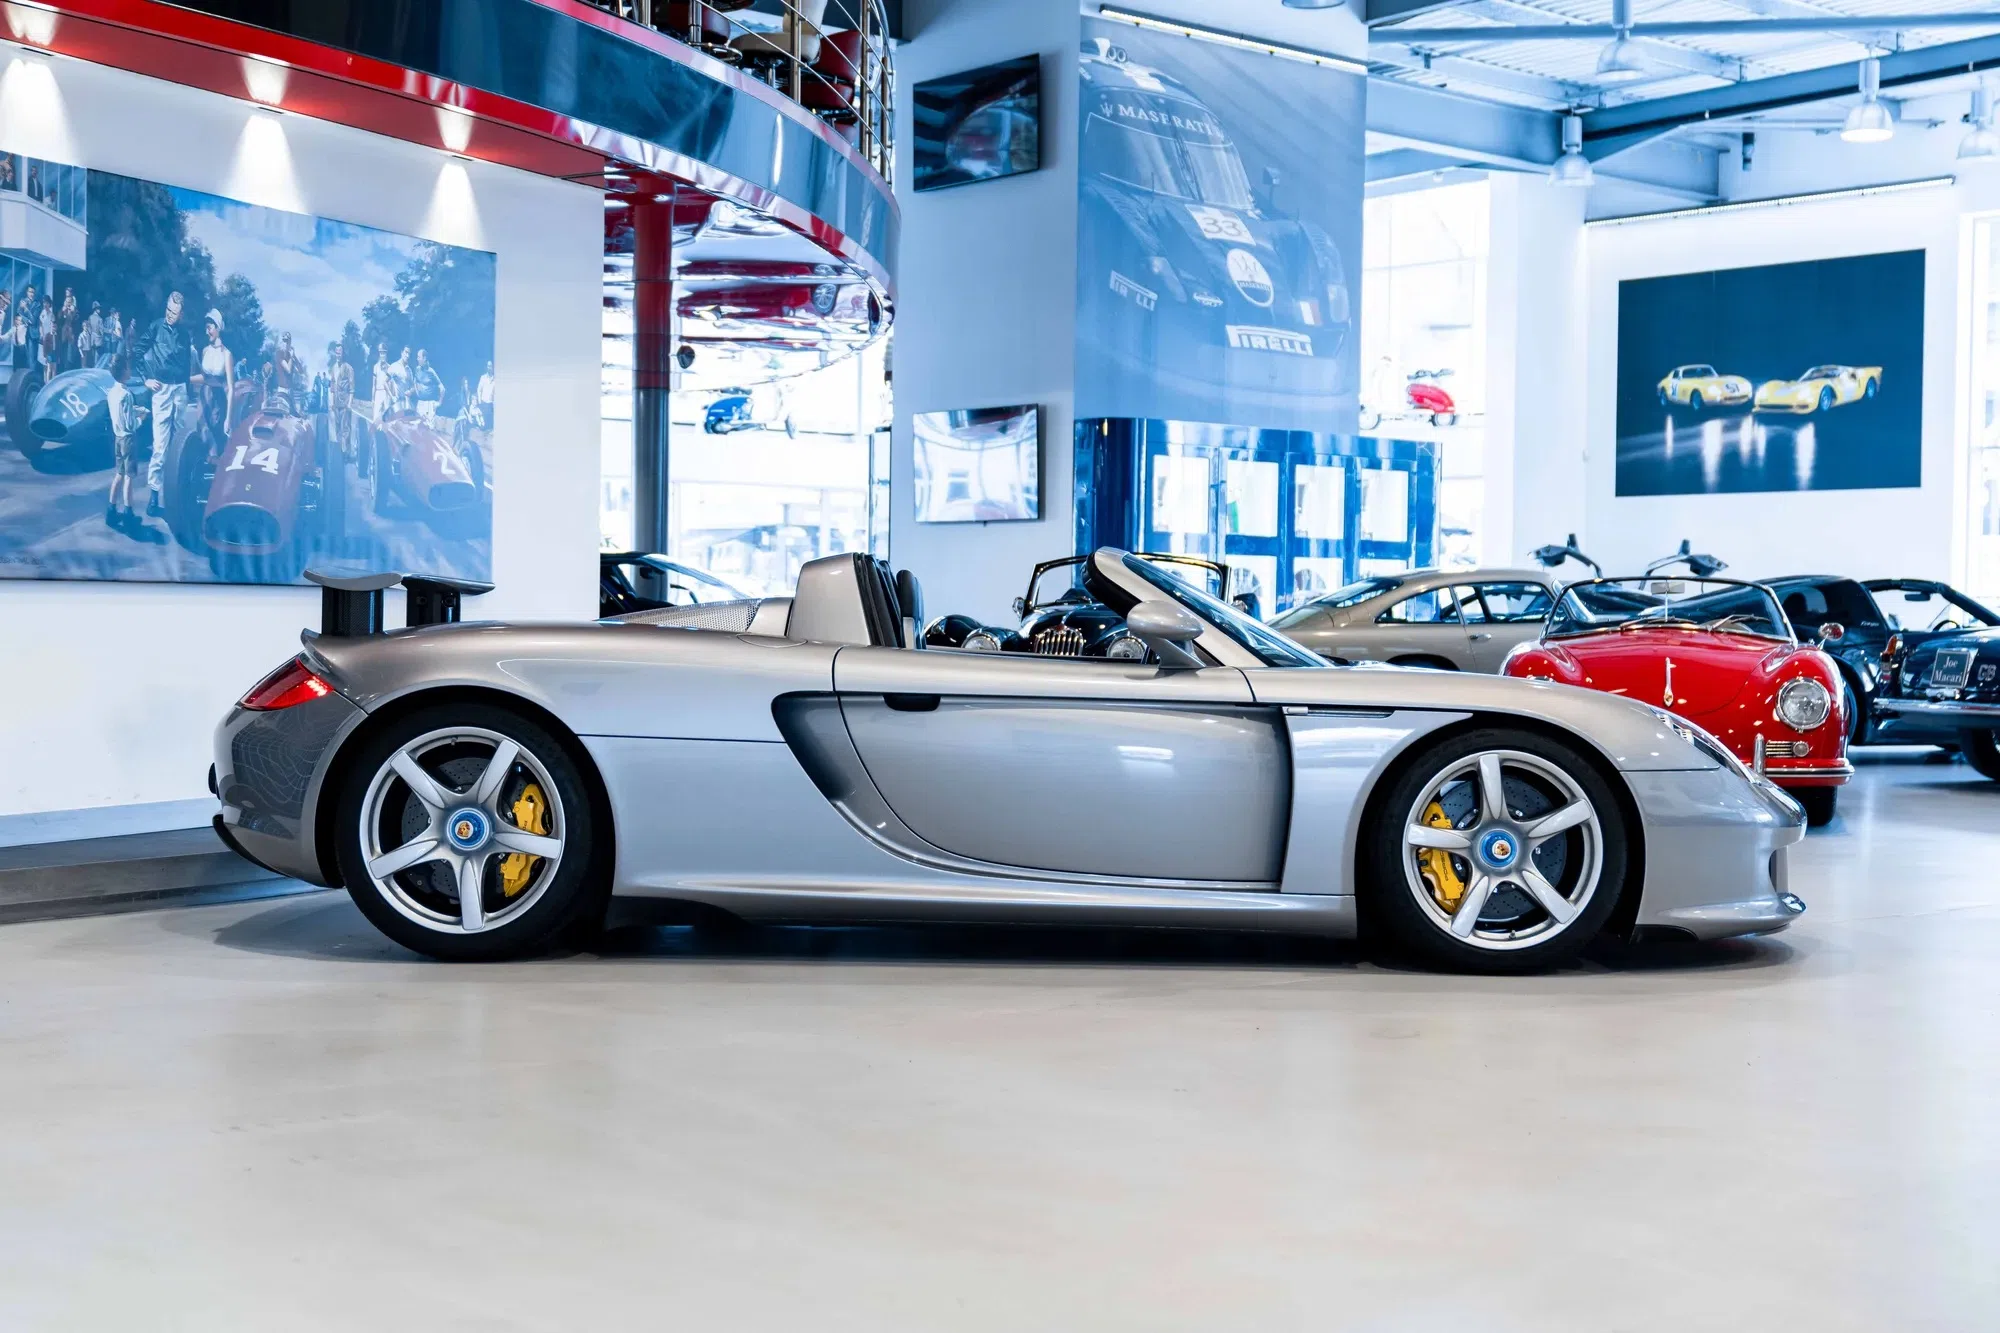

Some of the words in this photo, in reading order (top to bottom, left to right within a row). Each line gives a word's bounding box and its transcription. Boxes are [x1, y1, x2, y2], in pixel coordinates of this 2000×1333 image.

[1118, 103, 1213, 137] MASERATI
[1202, 217, 1243, 237] 33
[1109, 270, 1158, 312] PIRLLI
[1225, 324, 1313, 356] PIRELLI
[59, 392, 89, 418] 18
[225, 445, 279, 475] 14
[1943, 656, 1959, 668] Joe
[1977, 664, 1997, 681] GB
[1934, 670, 1964, 682] Macari
